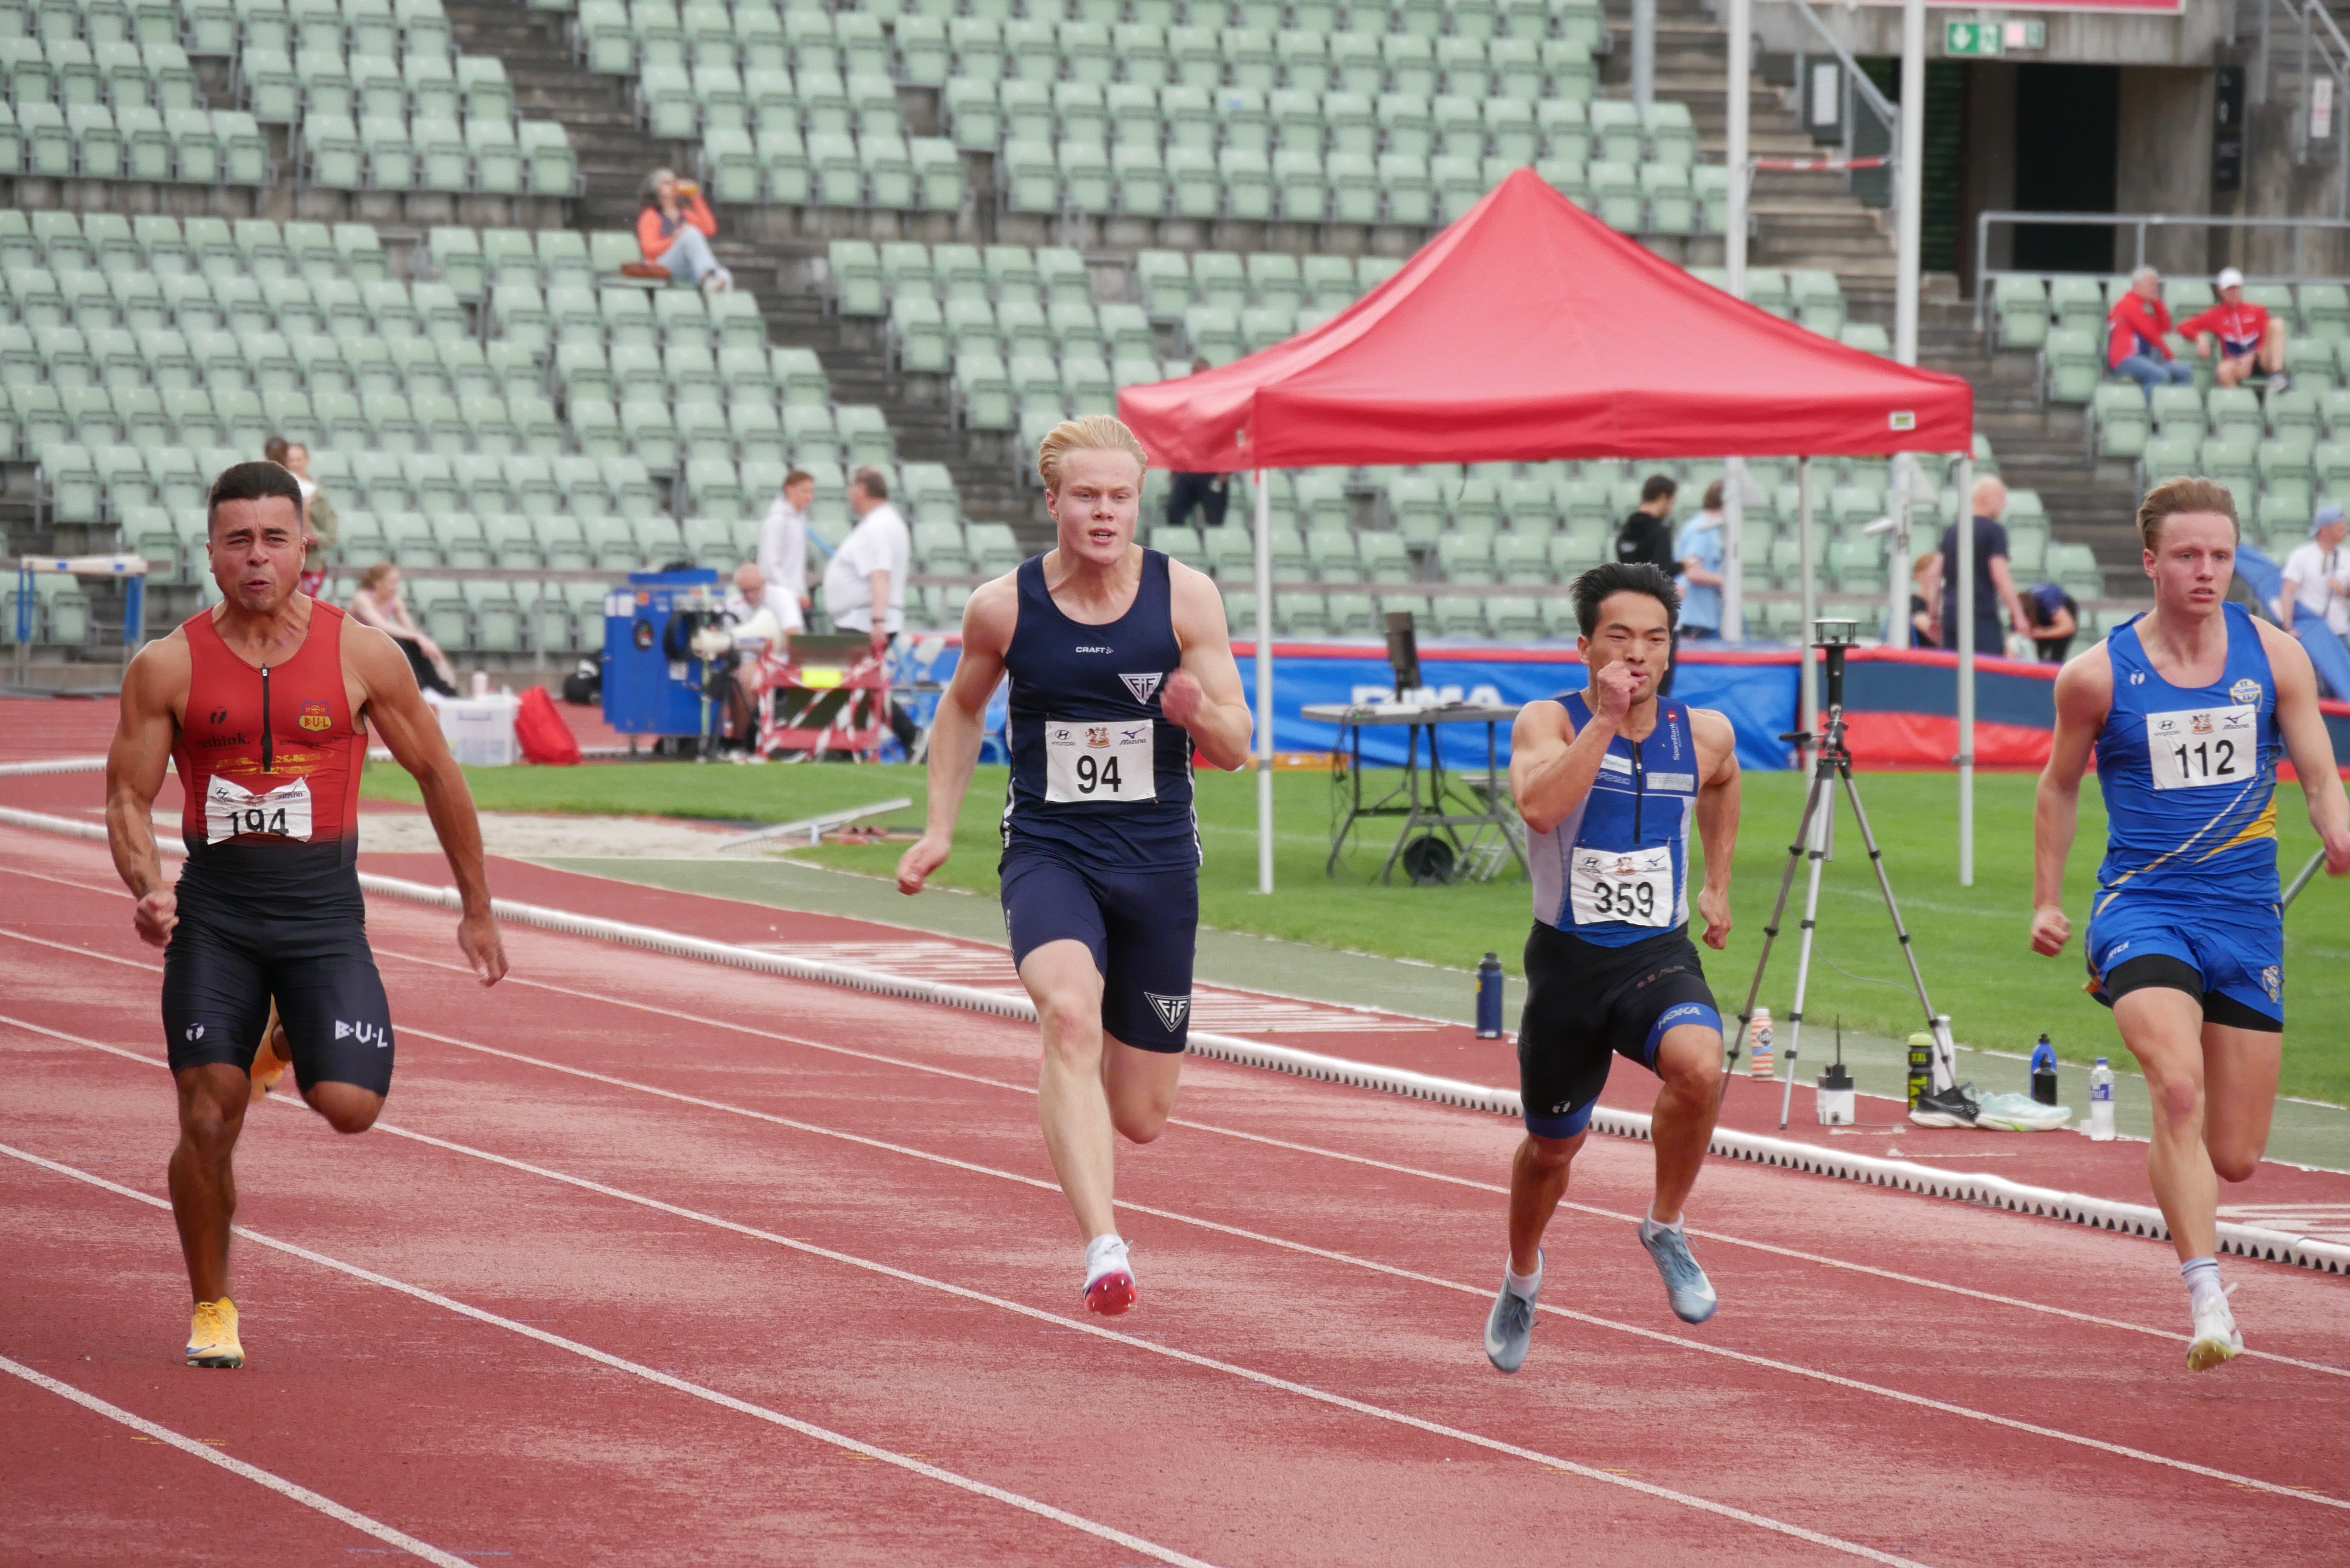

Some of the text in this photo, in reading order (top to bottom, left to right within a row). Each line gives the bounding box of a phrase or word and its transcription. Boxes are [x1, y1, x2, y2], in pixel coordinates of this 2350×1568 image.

[1668, 723, 1680, 760] SpareBank
[2174, 739, 2235, 778] 112
[1076, 755, 1121, 794] 94
[226, 808, 289, 836] 194
[1594, 881, 1654, 918] 359
[1658, 1006, 1702, 1031] HOKA
[1911, 1053, 1927, 1062] XXL
